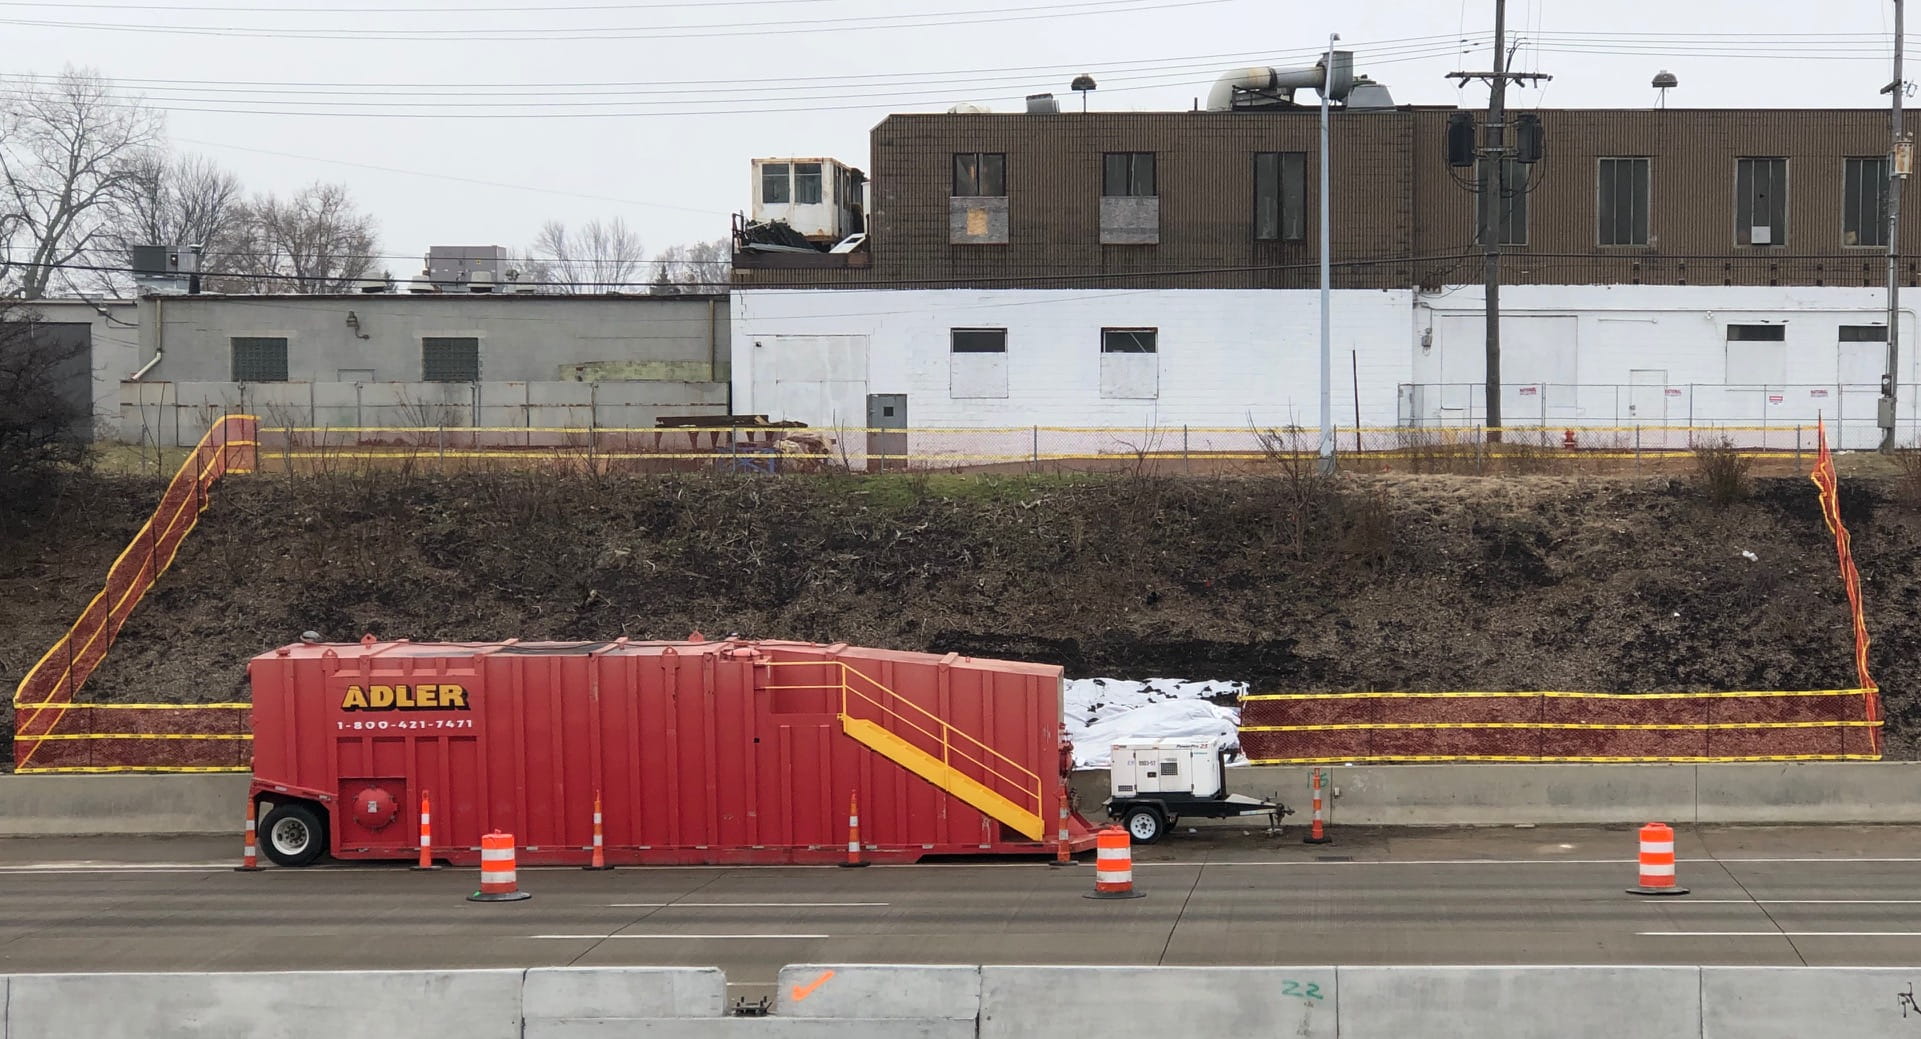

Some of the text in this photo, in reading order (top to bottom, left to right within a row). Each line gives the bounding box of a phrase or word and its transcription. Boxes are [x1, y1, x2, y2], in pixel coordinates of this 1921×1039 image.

[341, 684, 471, 711] ADLER
[337, 719, 473, 730] 1-800-421-7471
[1281, 980, 1324, 1000] 22
